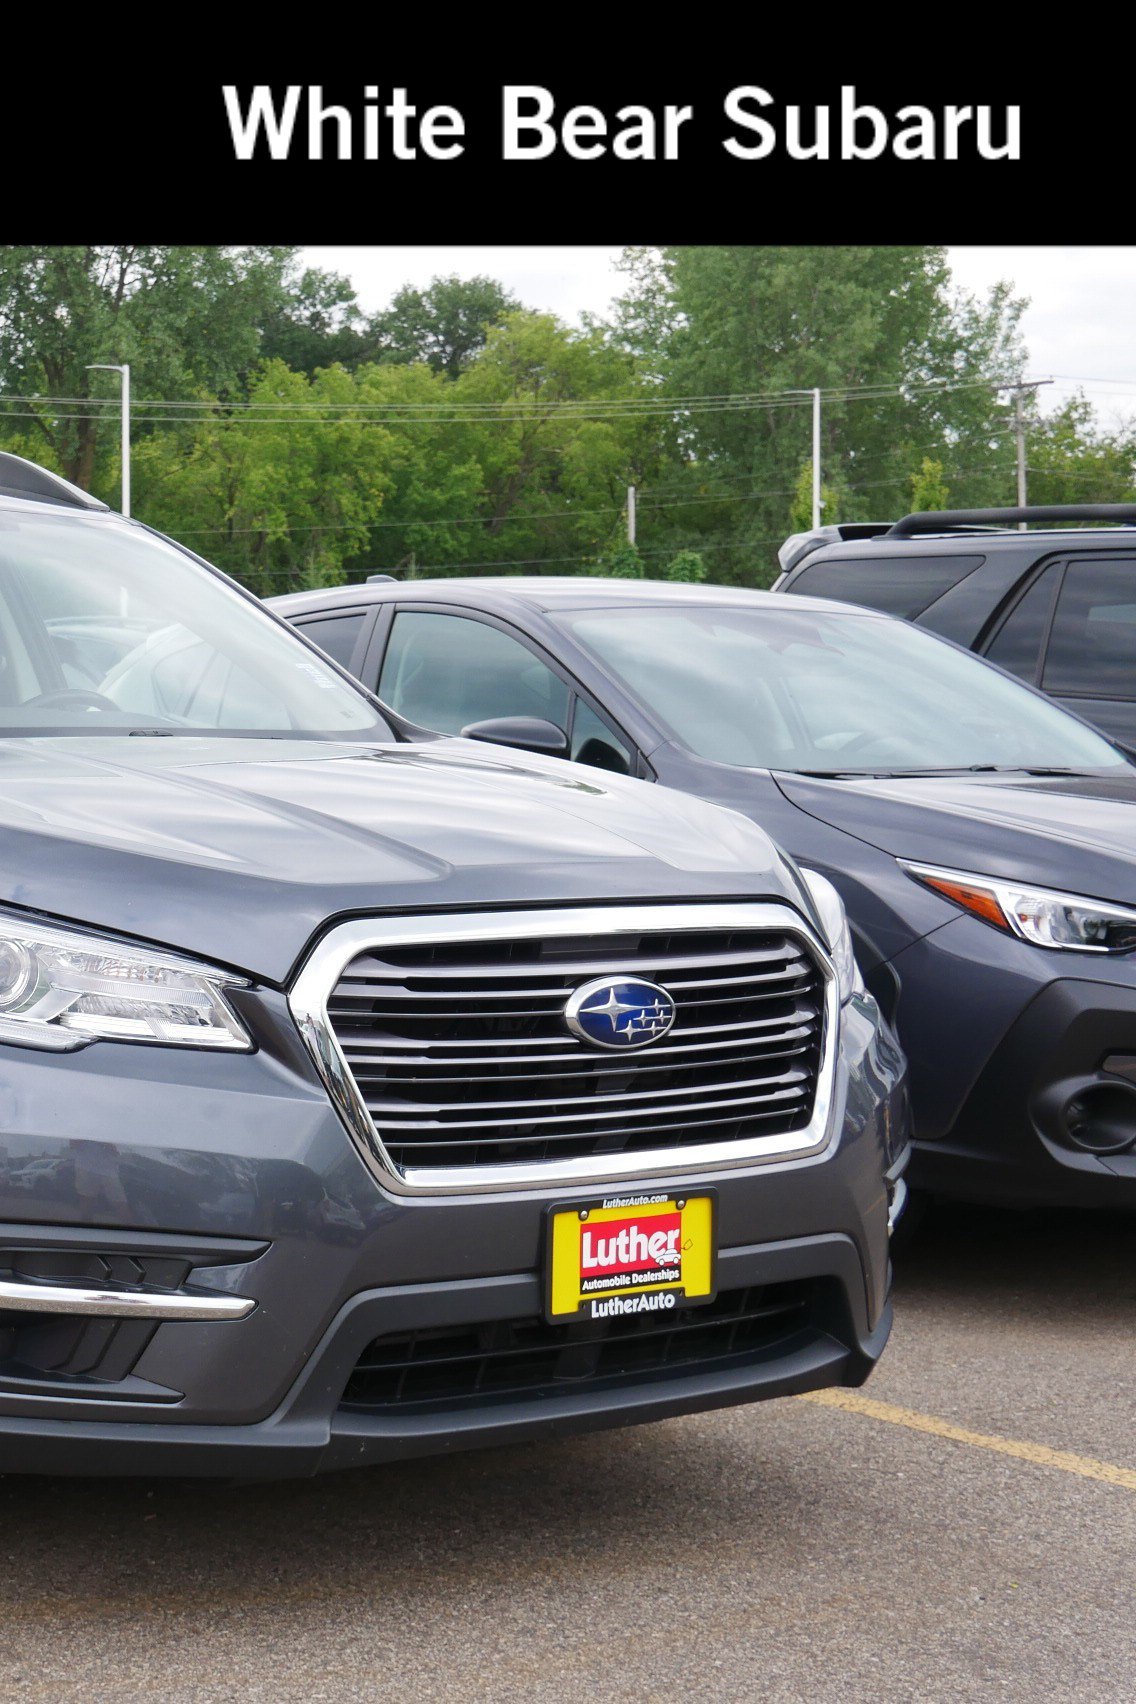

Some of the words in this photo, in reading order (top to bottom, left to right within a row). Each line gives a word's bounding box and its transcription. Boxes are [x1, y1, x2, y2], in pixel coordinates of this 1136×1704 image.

[602, 1194, 668, 1209] LutherAuto.com
[582, 1225, 680, 1269] Luther
[582, 1275, 631, 1291] Automobile
[632, 1268, 680, 1284] Dealerships
[591, 1292, 676, 1318] LutherAuto
